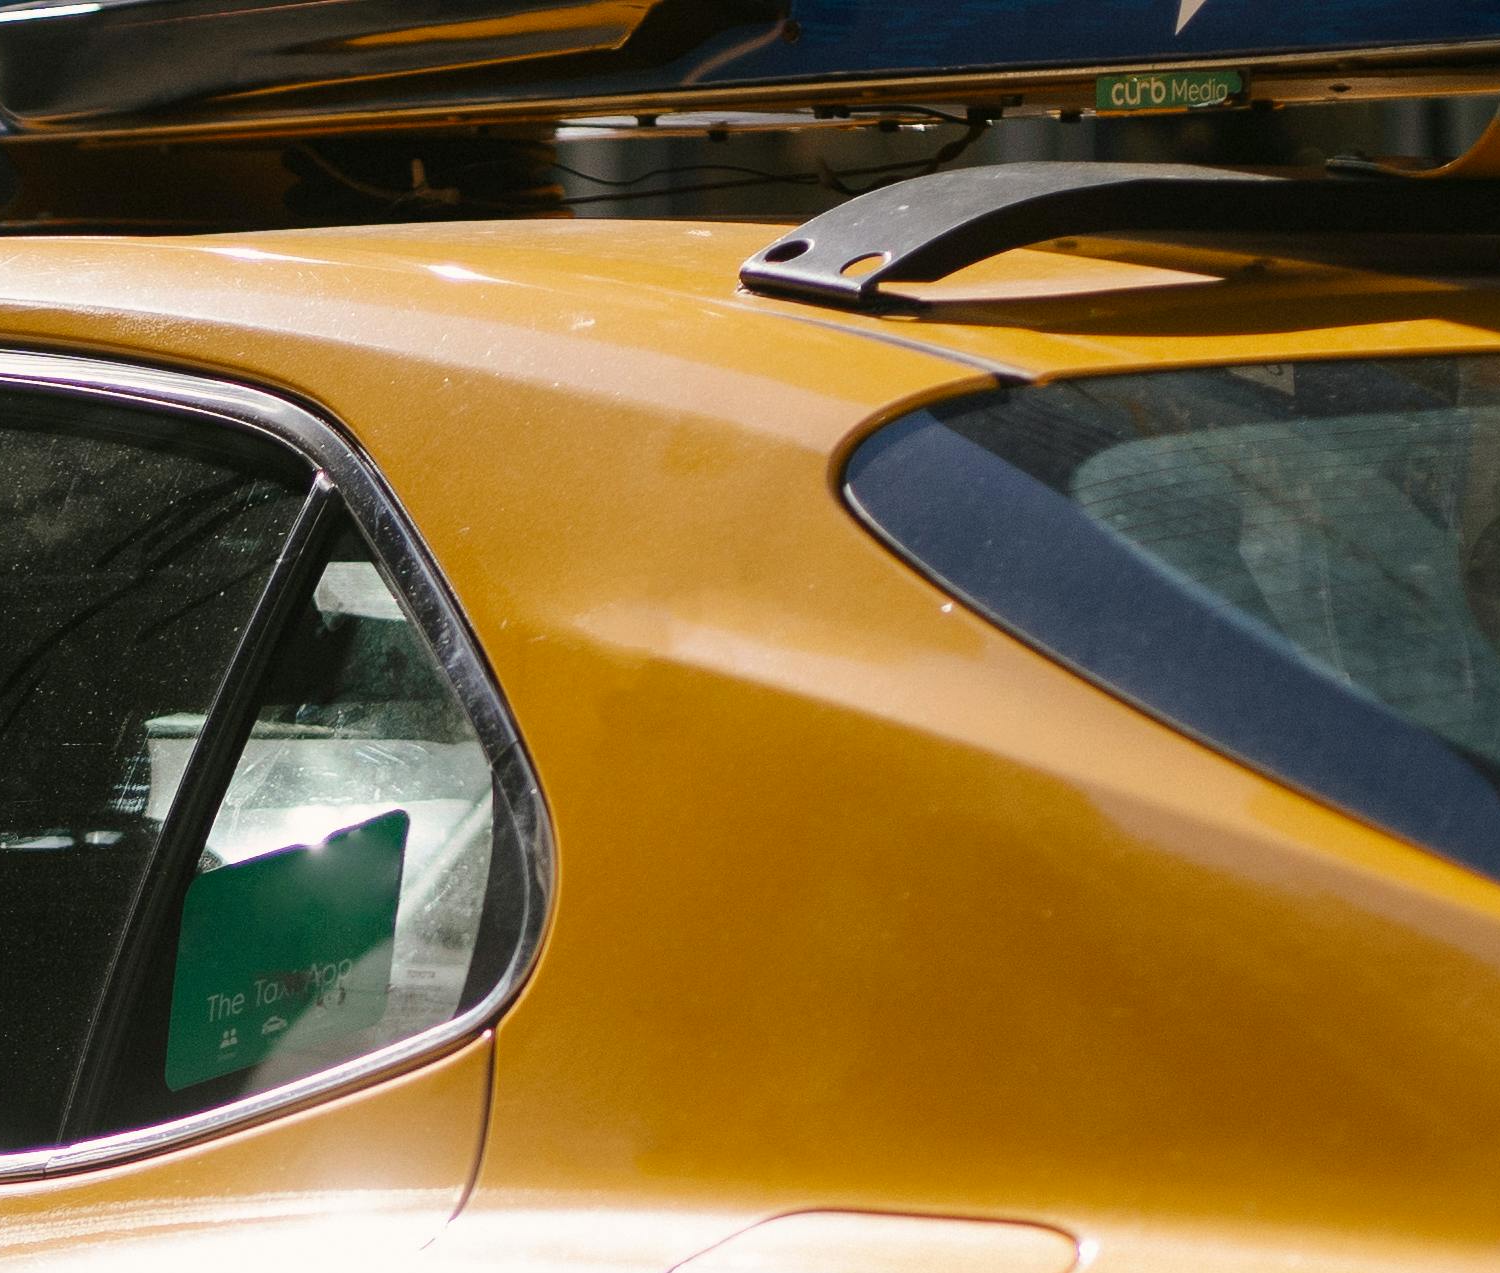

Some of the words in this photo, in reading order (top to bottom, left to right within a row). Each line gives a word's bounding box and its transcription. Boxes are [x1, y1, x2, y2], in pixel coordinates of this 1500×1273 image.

[1110, 77, 1167, 106] curb
[1171, 78, 1229, 101] Media
[206, 992, 246, 1022] The
[304, 958, 352, 997] App
